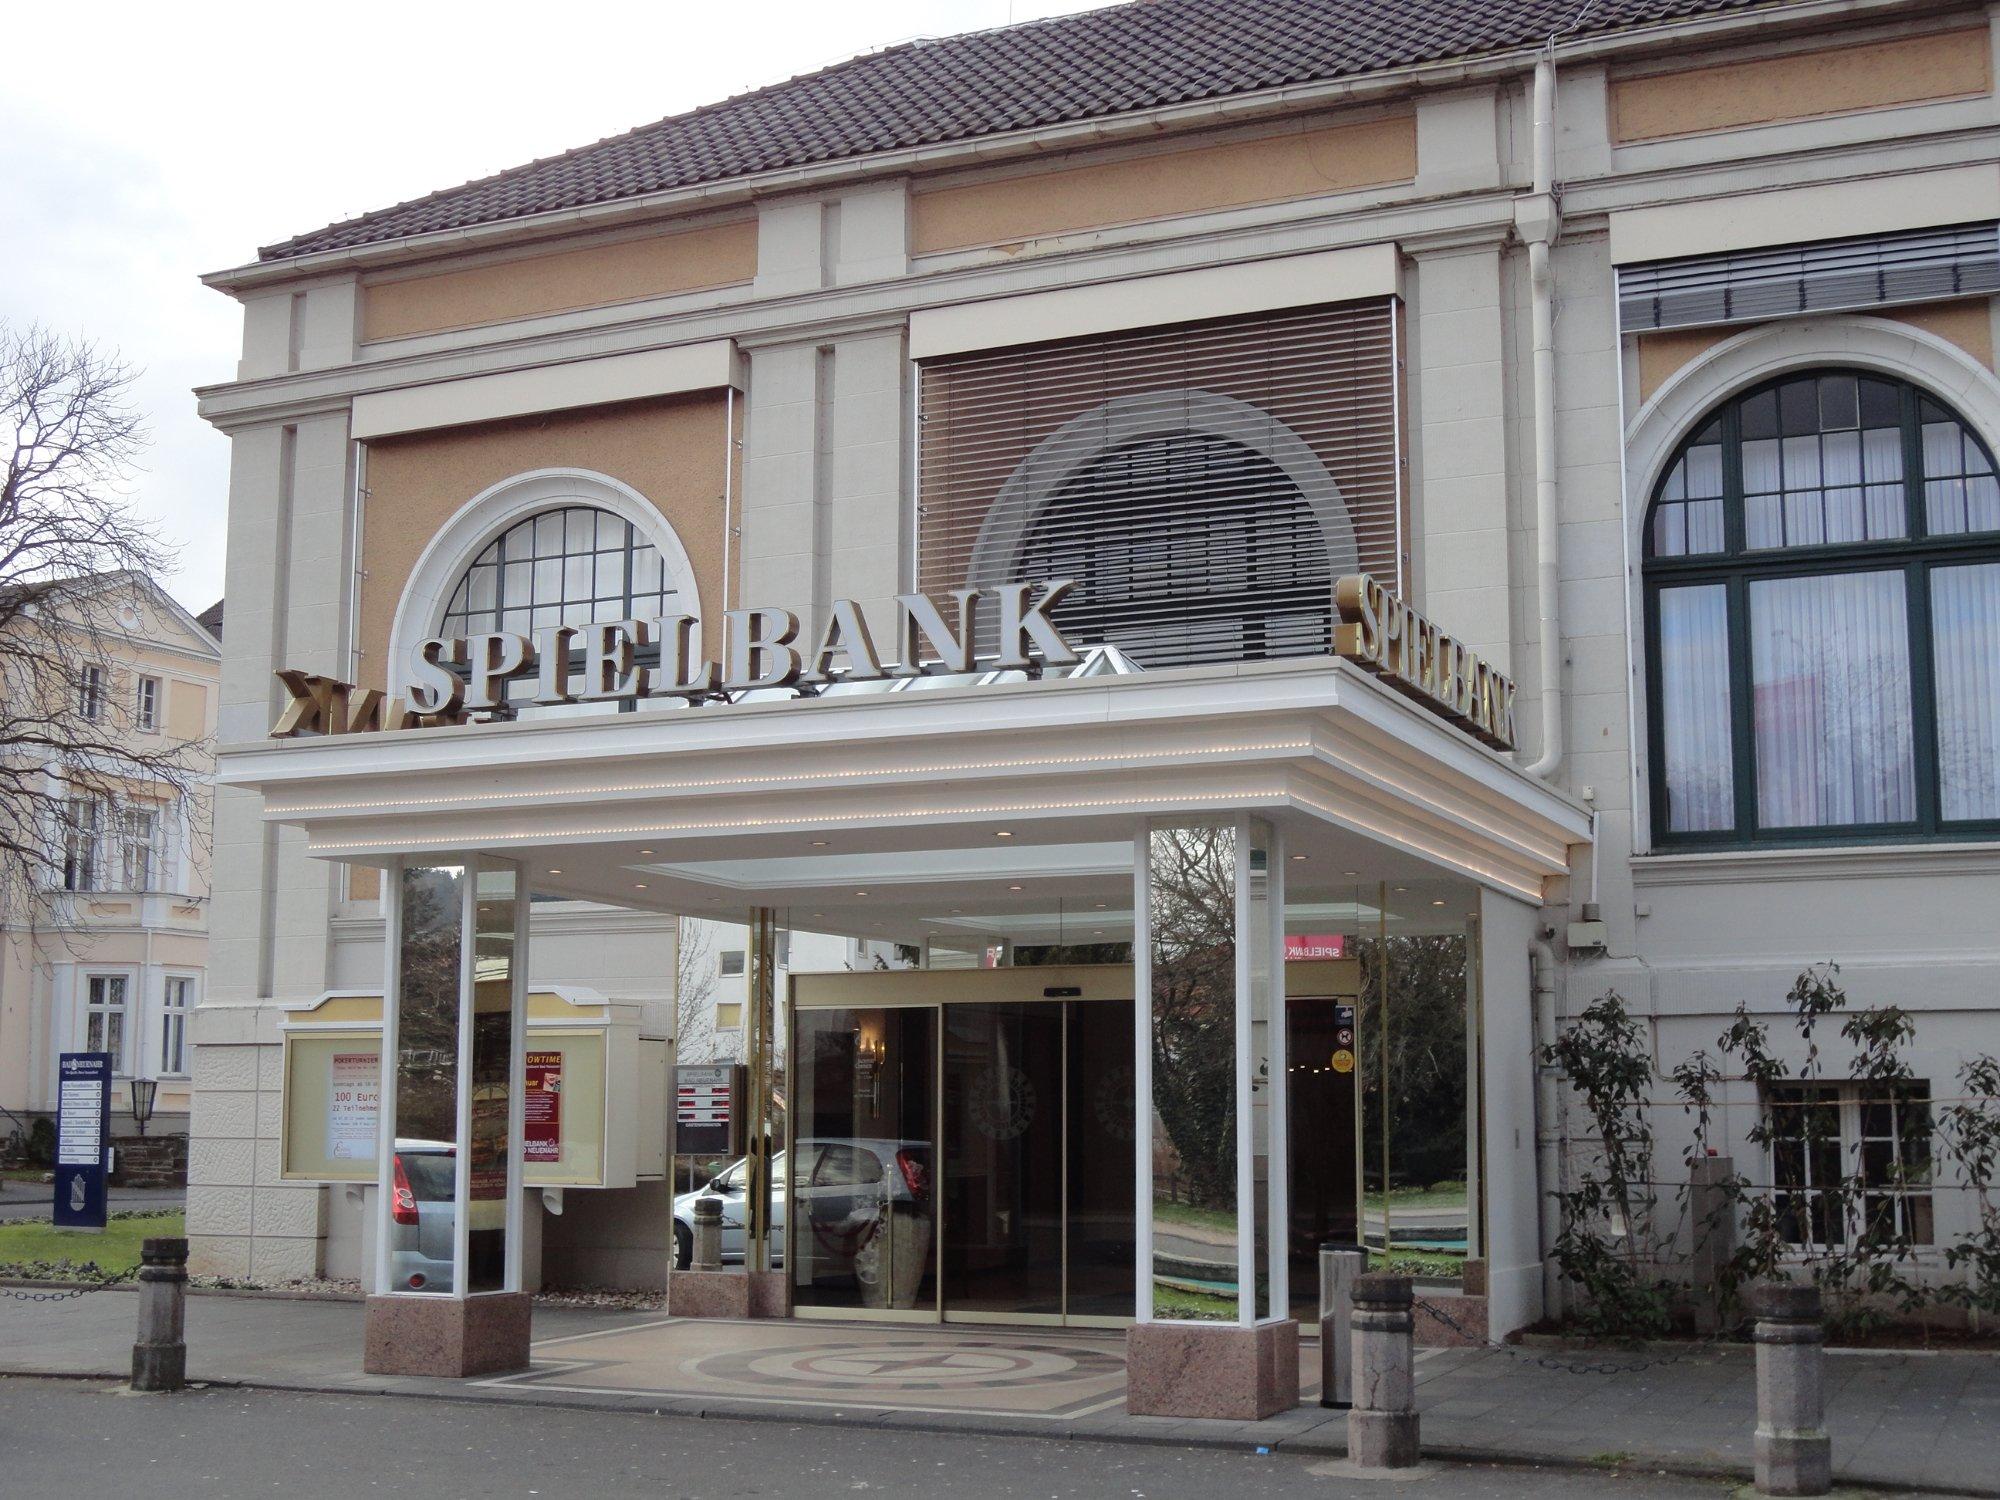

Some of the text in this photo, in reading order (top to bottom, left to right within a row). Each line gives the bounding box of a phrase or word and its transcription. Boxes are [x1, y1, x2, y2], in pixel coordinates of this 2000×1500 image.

[405, 579, 1083, 716] SPIELBANK
[1335, 573, 1520, 752] SPIELBANK
[335, 1092, 351, 1102] 100
[343, 1104, 377, 1112] Teilnehme
